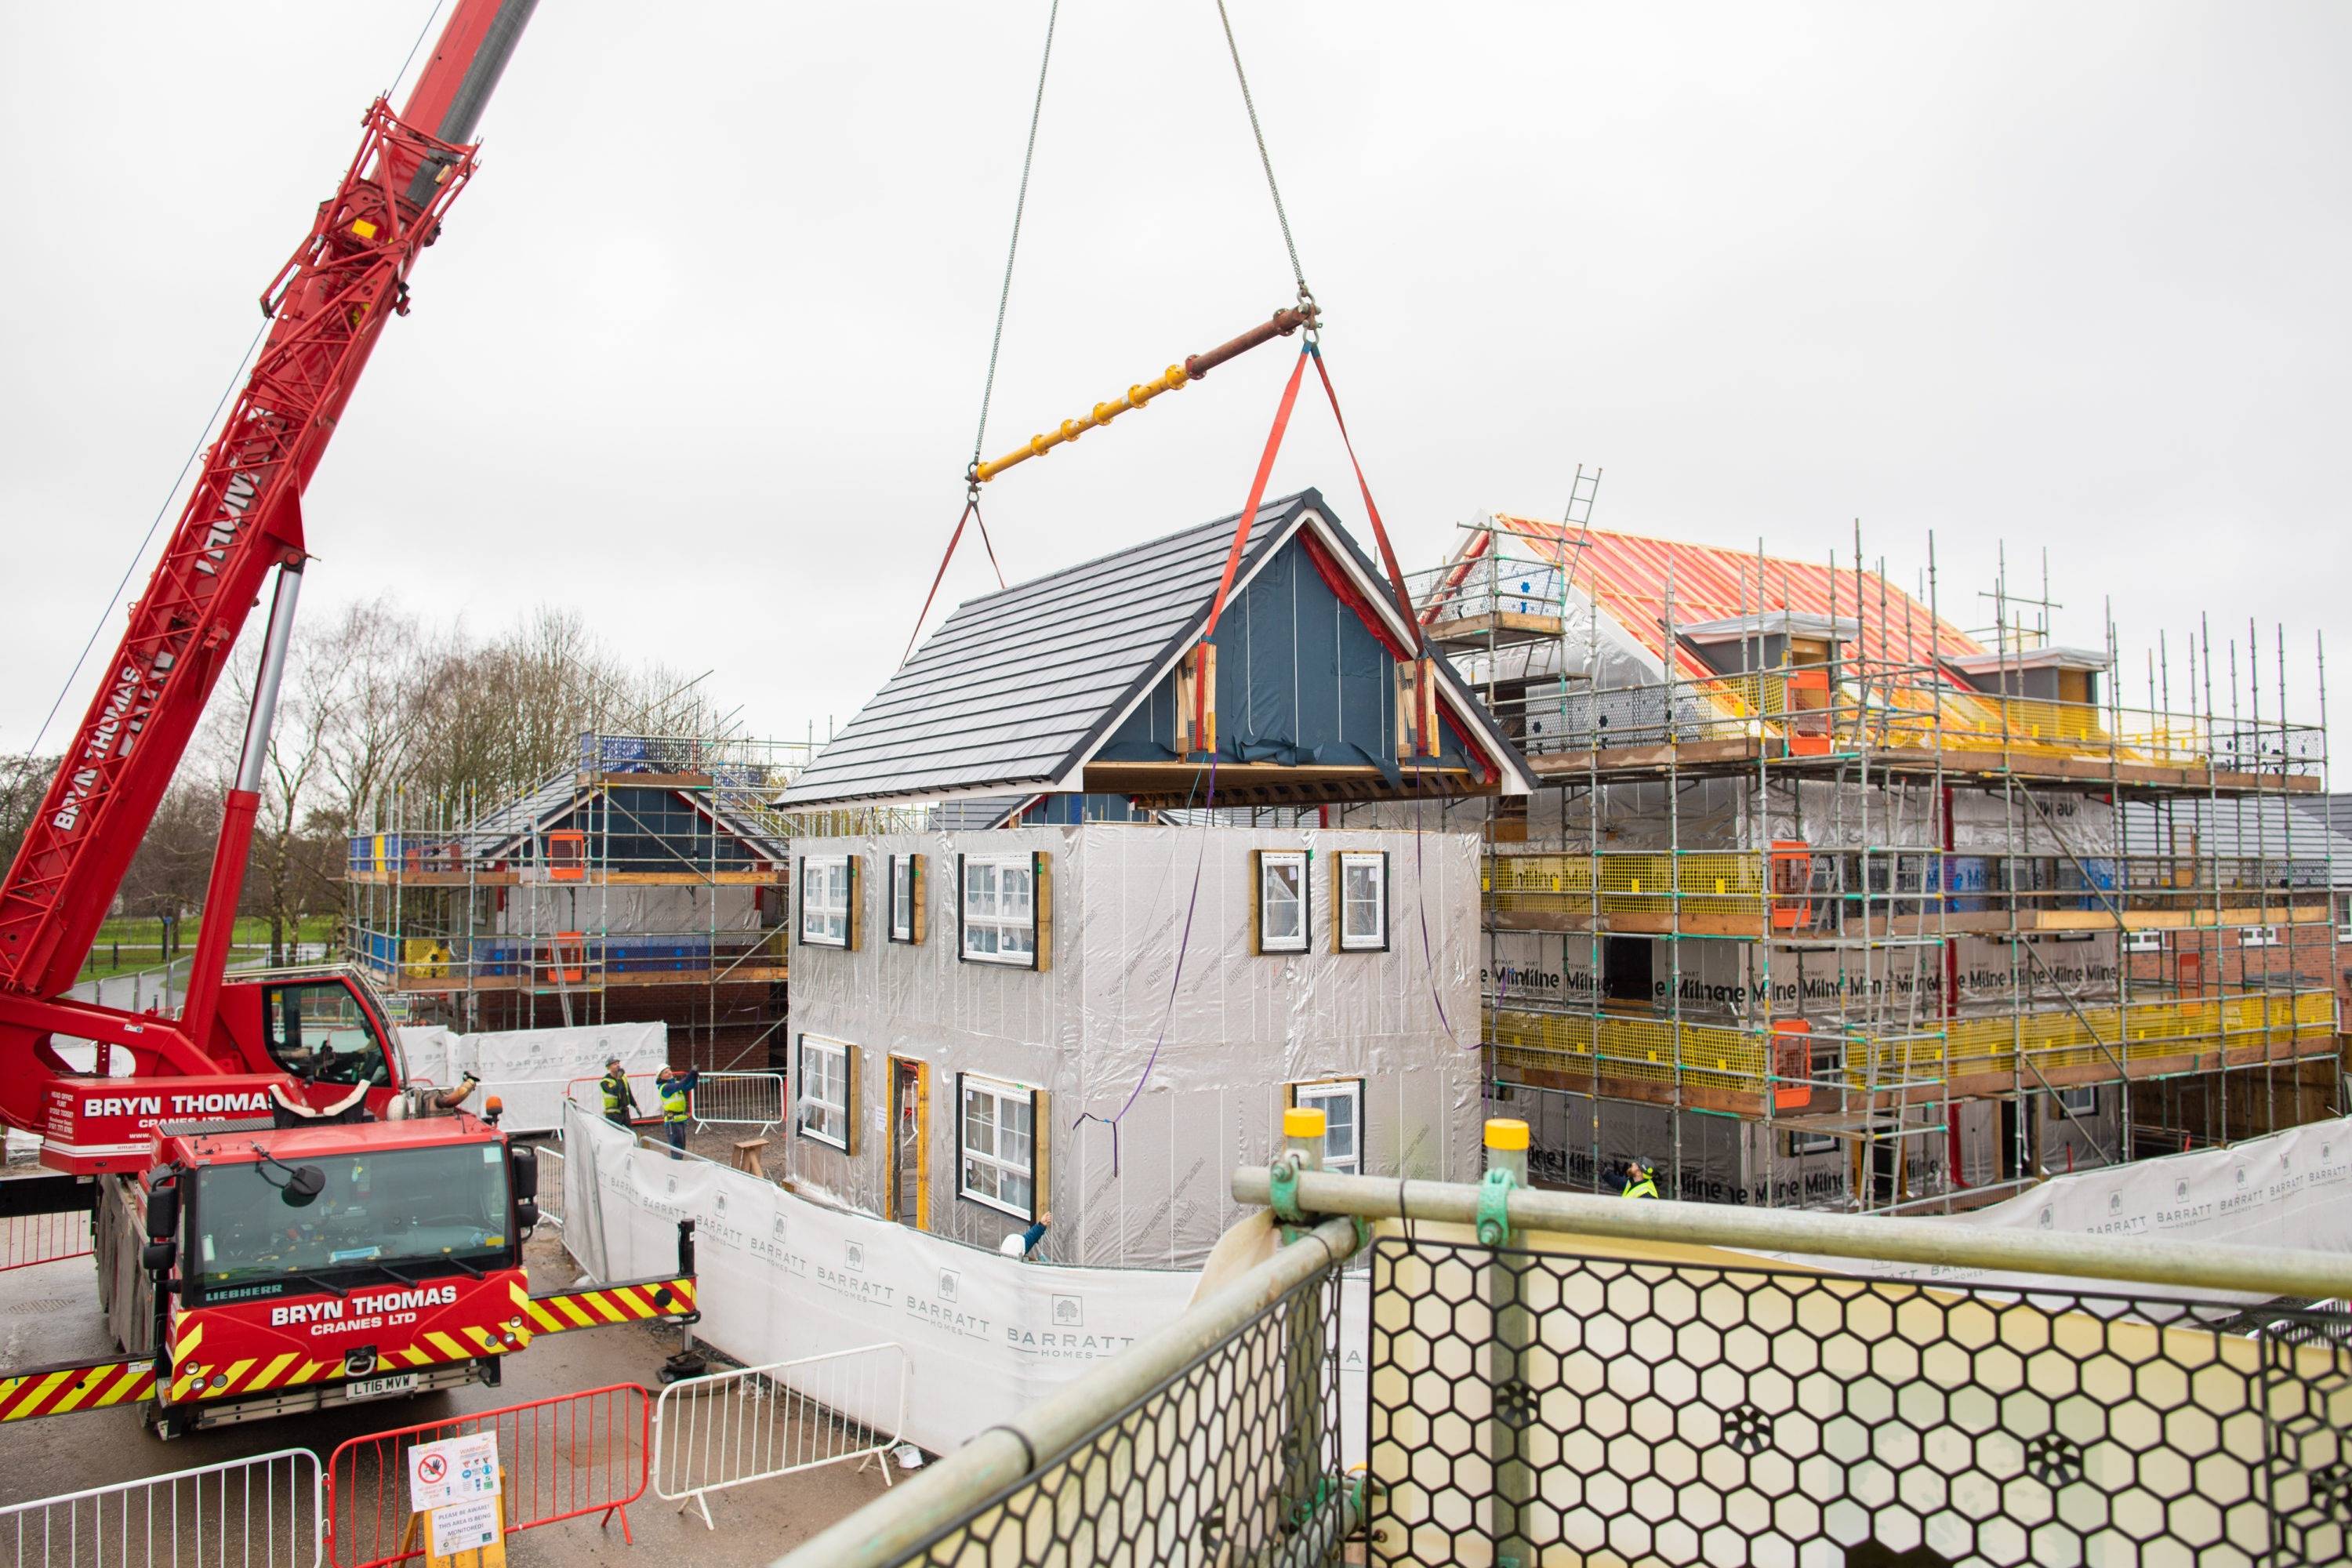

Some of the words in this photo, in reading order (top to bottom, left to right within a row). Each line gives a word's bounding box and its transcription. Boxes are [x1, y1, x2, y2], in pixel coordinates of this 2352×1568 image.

[53, 765, 98, 831] BRYN
[84, 666, 140, 759] THOMAS
[1970, 970, 2005, 989] Milne
[2049, 966, 2082, 983] Milne
[2086, 964, 2117, 981] Milne
[84, 1097, 162, 1117] BRYN
[2308, 1165, 2347, 1182] BARRATT
[2270, 1174, 2304, 1196] BARRATT
[643, 1196, 688, 1222] BARRATT
[2220, 1189, 2263, 1210] BARRATT
[2157, 1203, 2212, 1223] BARRATT
[695, 1215, 744, 1243] BARRATT
[2087, 1216, 2147, 1234] BARRATT
[750, 1237, 808, 1271] BARRATT
[766, 1257, 789, 1273] HOMES
[205, 1284, 283, 1301] LIEBHERR
[817, 1266, 895, 1300] BARRATT
[837, 1288, 869, 1304] HOMES
[271, 1300, 343, 1327] BRYN
[351, 1286, 457, 1316] THOMAS
[906, 1295, 990, 1334] BARRATT
[310, 1317, 383, 1336] CRANES
[388, 1312, 416, 1326] LTD
[930, 1319, 964, 1337] HOMES
[1007, 1327, 1135, 1350] BARRATT
[1040, 1348, 1094, 1360] HOMES
[354, 1378, 383, 1395] LT16
[385, 1374, 410, 1389] MVW
[438, 1511, 458, 1520] PLEASE
[466, 1504, 489, 1514] AWARE!
[474, 1512, 491, 1522] BEING
[447, 1523, 484, 1537] MONITORED!
